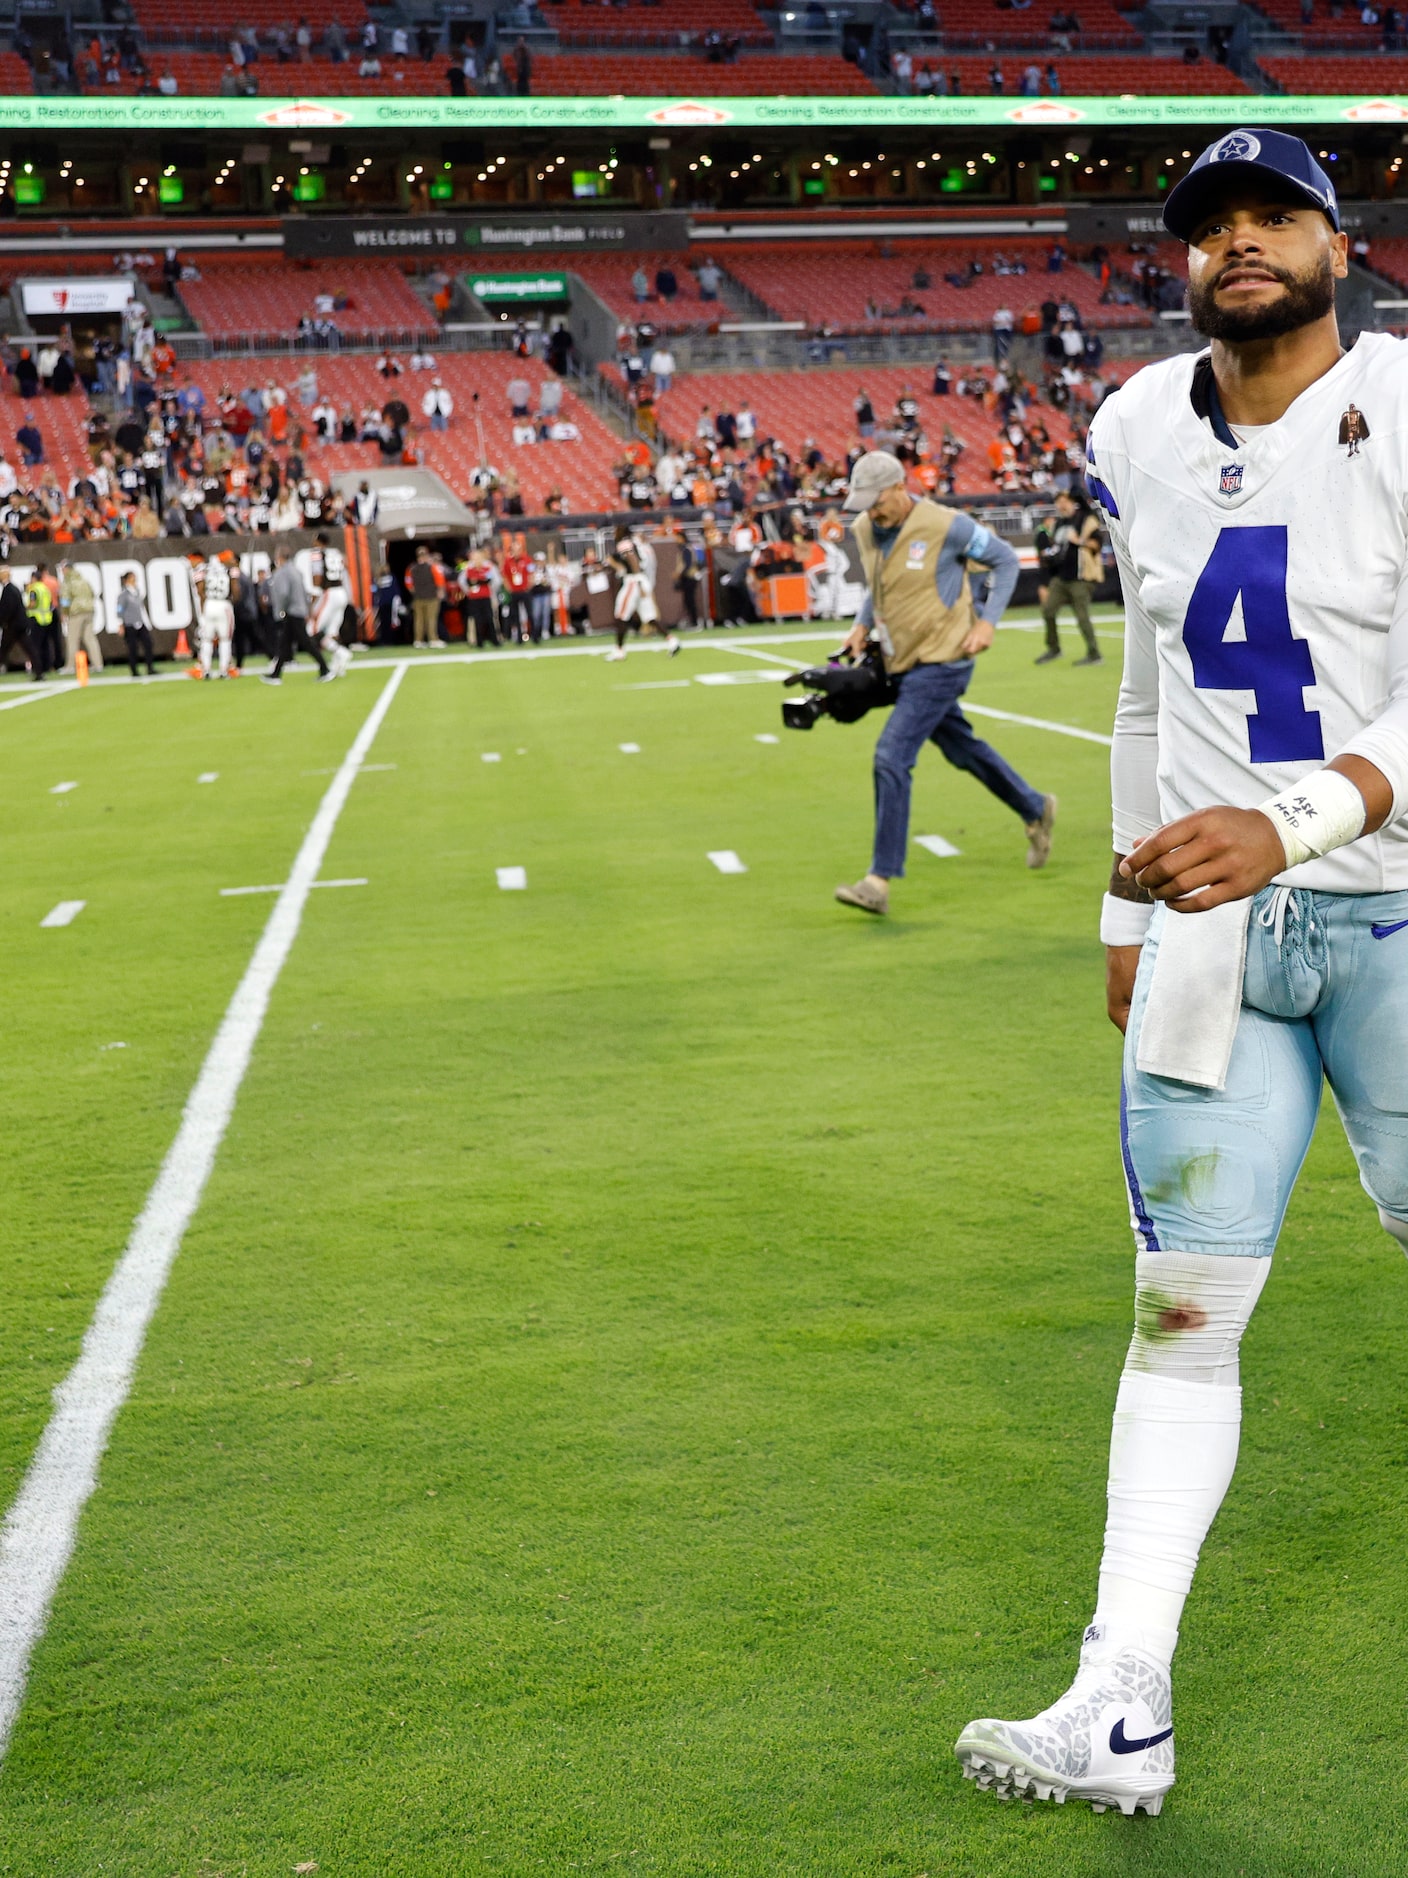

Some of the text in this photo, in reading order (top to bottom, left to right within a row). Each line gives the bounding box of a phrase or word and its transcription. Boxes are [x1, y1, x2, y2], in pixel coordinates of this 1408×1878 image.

[1126, 217, 1165, 233] WELC
[353, 229, 433, 246] WELCOME
[435, 228, 456, 244] TO
[481, 226, 550, 245] Huntington
[552, 225, 586, 242] Bank
[486, 279, 563, 296] Huntington Bank
[1221, 477, 1239, 491] NFL
[1182, 525, 1325, 764] 4
[1292, 796, 1318, 819] ASK
